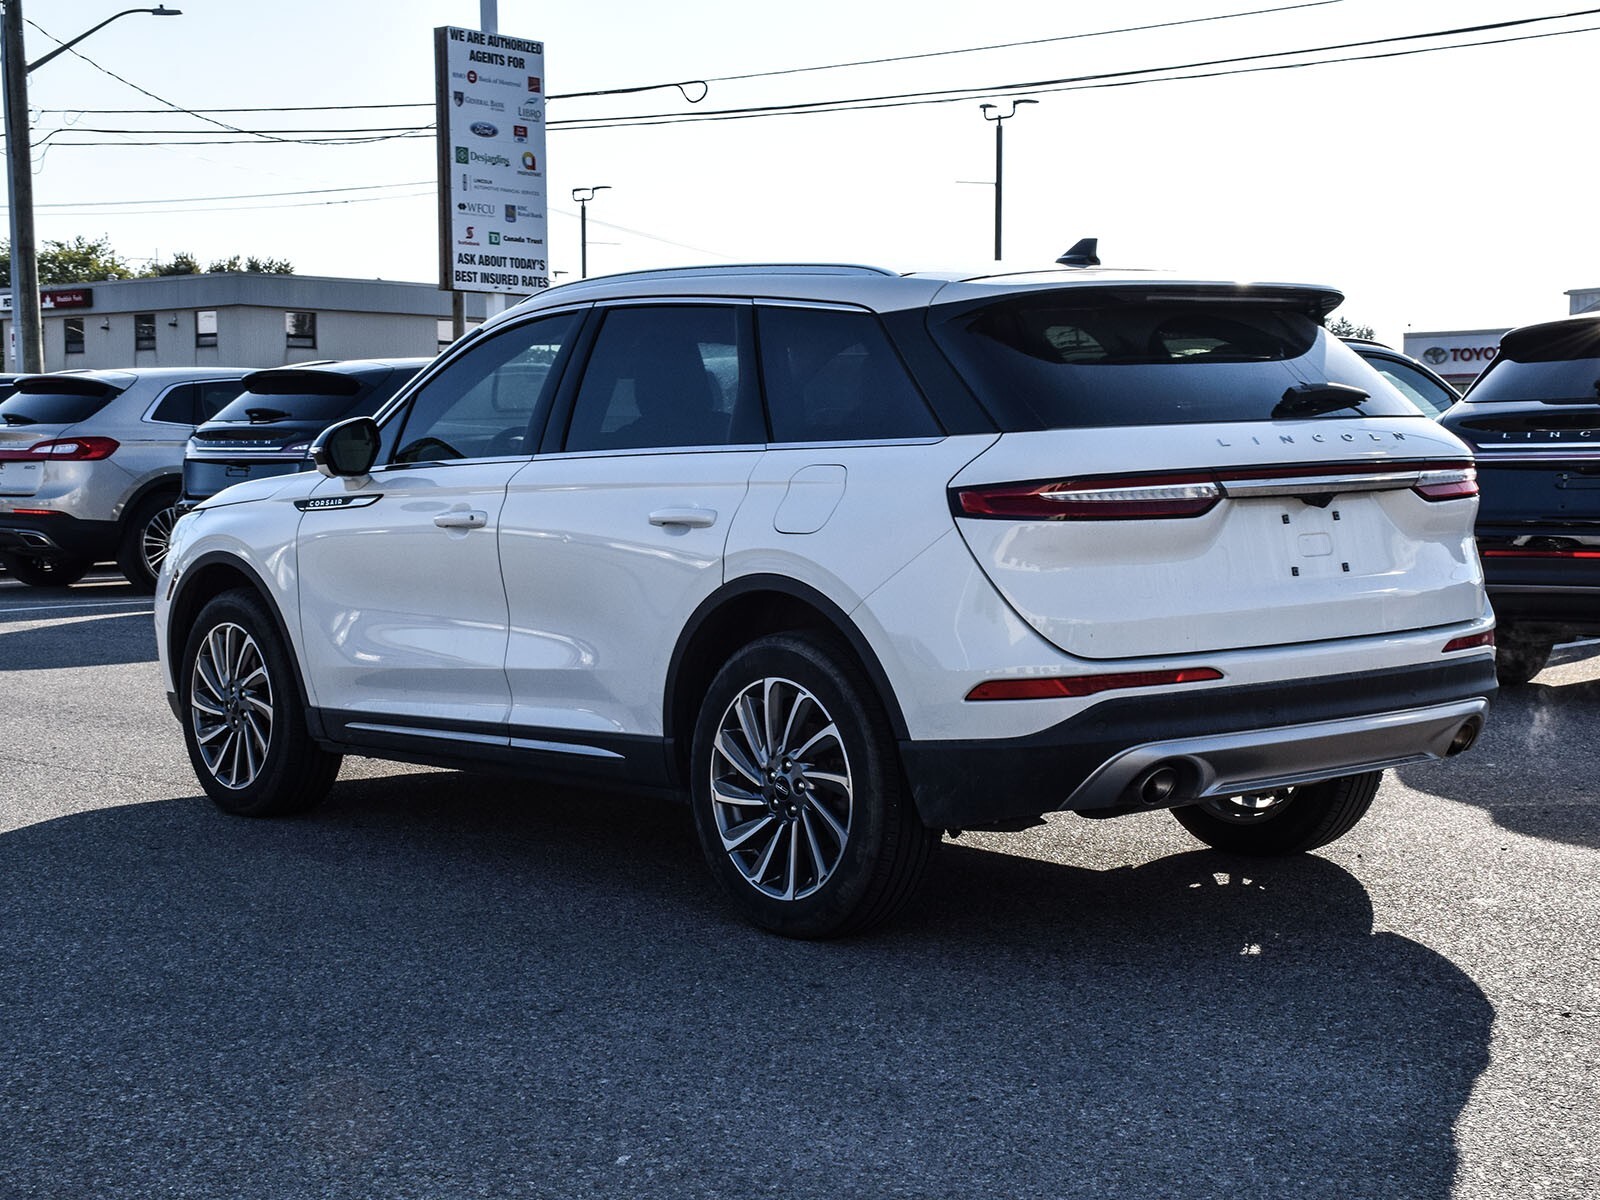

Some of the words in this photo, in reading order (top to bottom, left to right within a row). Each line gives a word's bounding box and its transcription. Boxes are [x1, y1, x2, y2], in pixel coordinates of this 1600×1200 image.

[449, 28, 465, 42] WE
[467, 31, 486, 45] ARE
[487, 35, 542, 55] AUTHORIZED
[469, 50, 506, 66] AGENTS
[507, 56, 525, 69] FOR
[518, 107, 542, 119] LIBRO
[470, 152, 510, 166] Desjardins
[467, 202, 496, 214] WFCU
[503, 235, 525, 243] Canada
[526, 237, 543, 245] Trust
[457, 253, 476, 265] ASK
[478, 254, 507, 267] ABOUT
[509, 257, 545, 271] TODAY'S
[455, 270, 478, 283] BEST
[480, 272, 519, 286] INSURED
[521, 275, 549, 288] RATES
[1216, 431, 1405, 447] LINCOLN
[309, 498, 343, 507] CORSAIR
